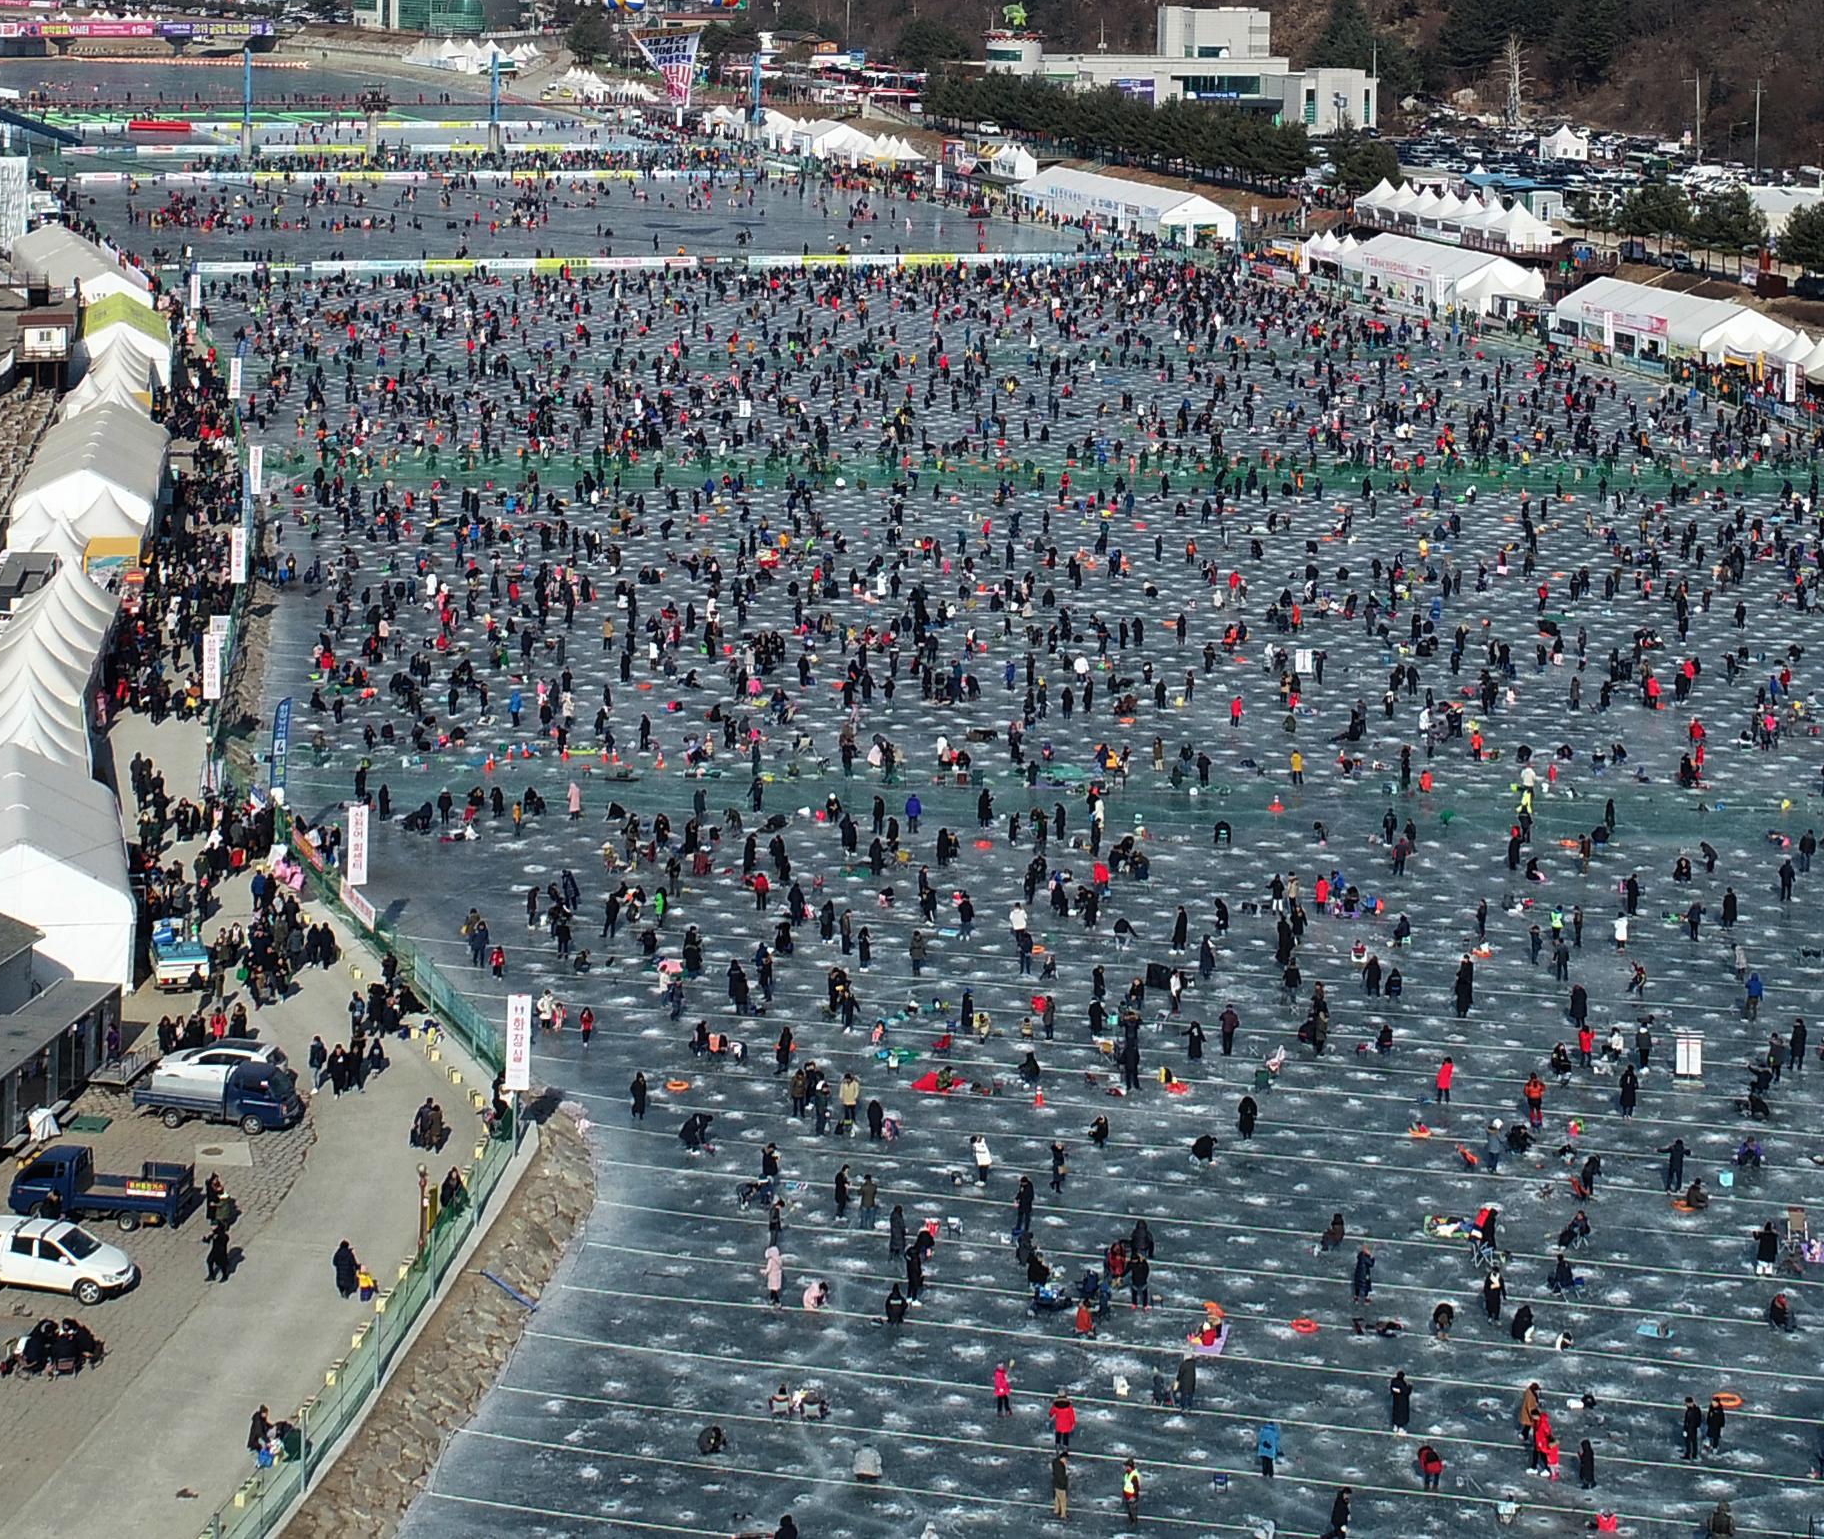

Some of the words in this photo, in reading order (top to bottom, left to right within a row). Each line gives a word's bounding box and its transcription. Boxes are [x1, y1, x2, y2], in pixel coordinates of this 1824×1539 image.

[192, 24, 208, 34] 2019
[277, 741, 284, 752] 4
[353, 811, 363, 840] 산천어
[513, 1017, 524, 1063] 화장실
